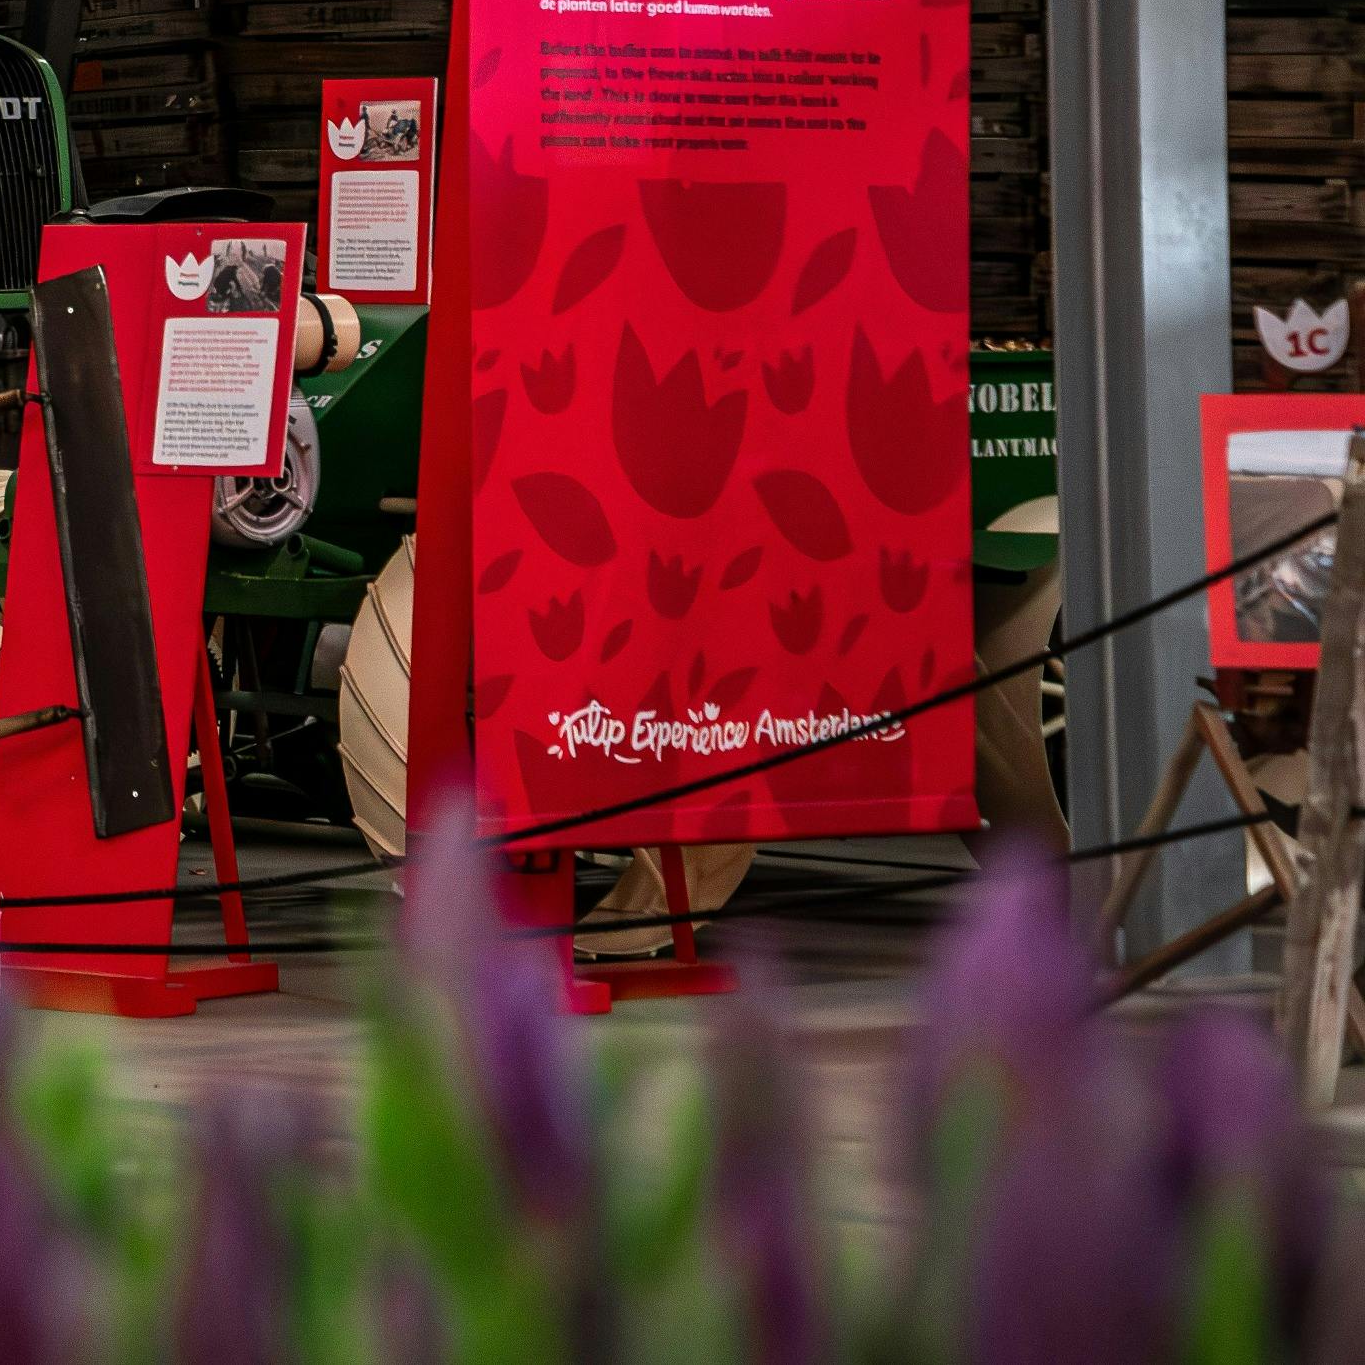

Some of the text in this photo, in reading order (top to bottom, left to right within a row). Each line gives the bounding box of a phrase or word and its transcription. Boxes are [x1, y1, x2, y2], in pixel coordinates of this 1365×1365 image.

[1287, 329, 1330, 358] 1C
[558, 700, 626, 759] Tulip
[632, 710, 750, 762] Experience
